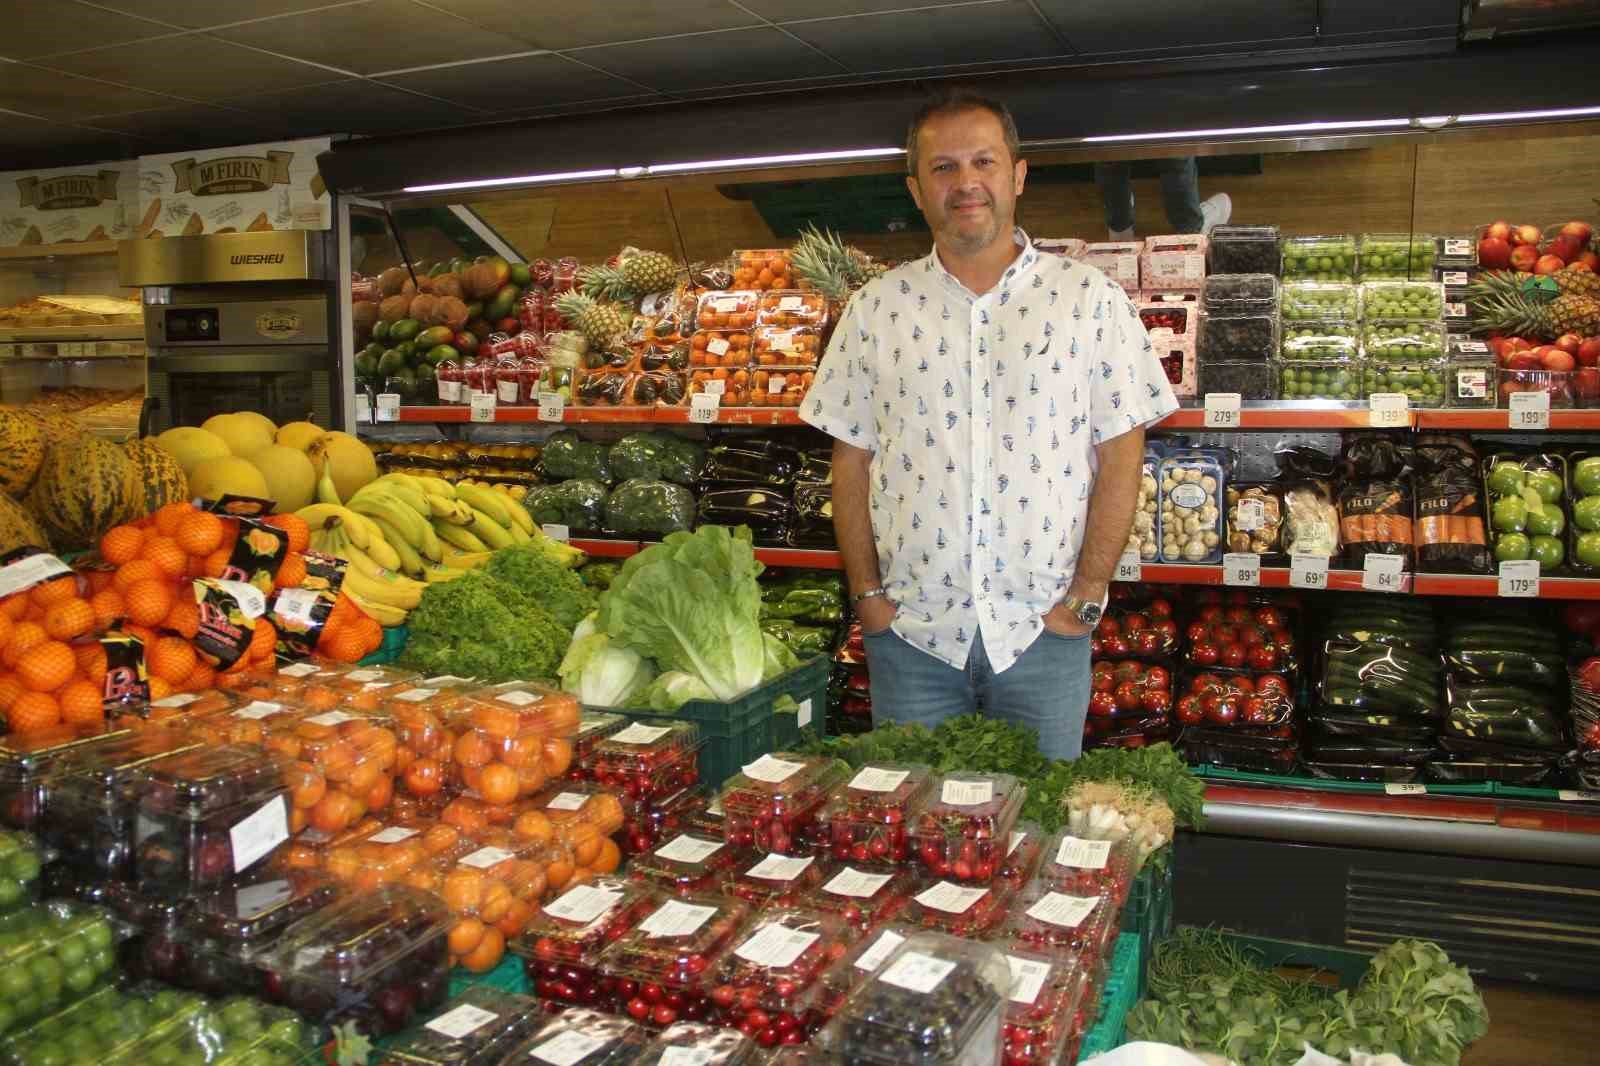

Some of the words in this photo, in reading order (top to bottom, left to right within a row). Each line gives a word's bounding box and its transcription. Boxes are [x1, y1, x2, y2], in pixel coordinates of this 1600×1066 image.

[217, 161, 263, 180] FIRIN
[230, 254, 285, 265] WIESHEU
[1214, 411, 1231, 423] 279
[1521, 412, 1538, 424] 199
[1120, 566, 1131, 576] 84
[1238, 569, 1250, 581] 89
[1305, 572, 1318, 584] 69
[1378, 573, 1391, 585] 64
[1509, 579, 1529, 592] 179
